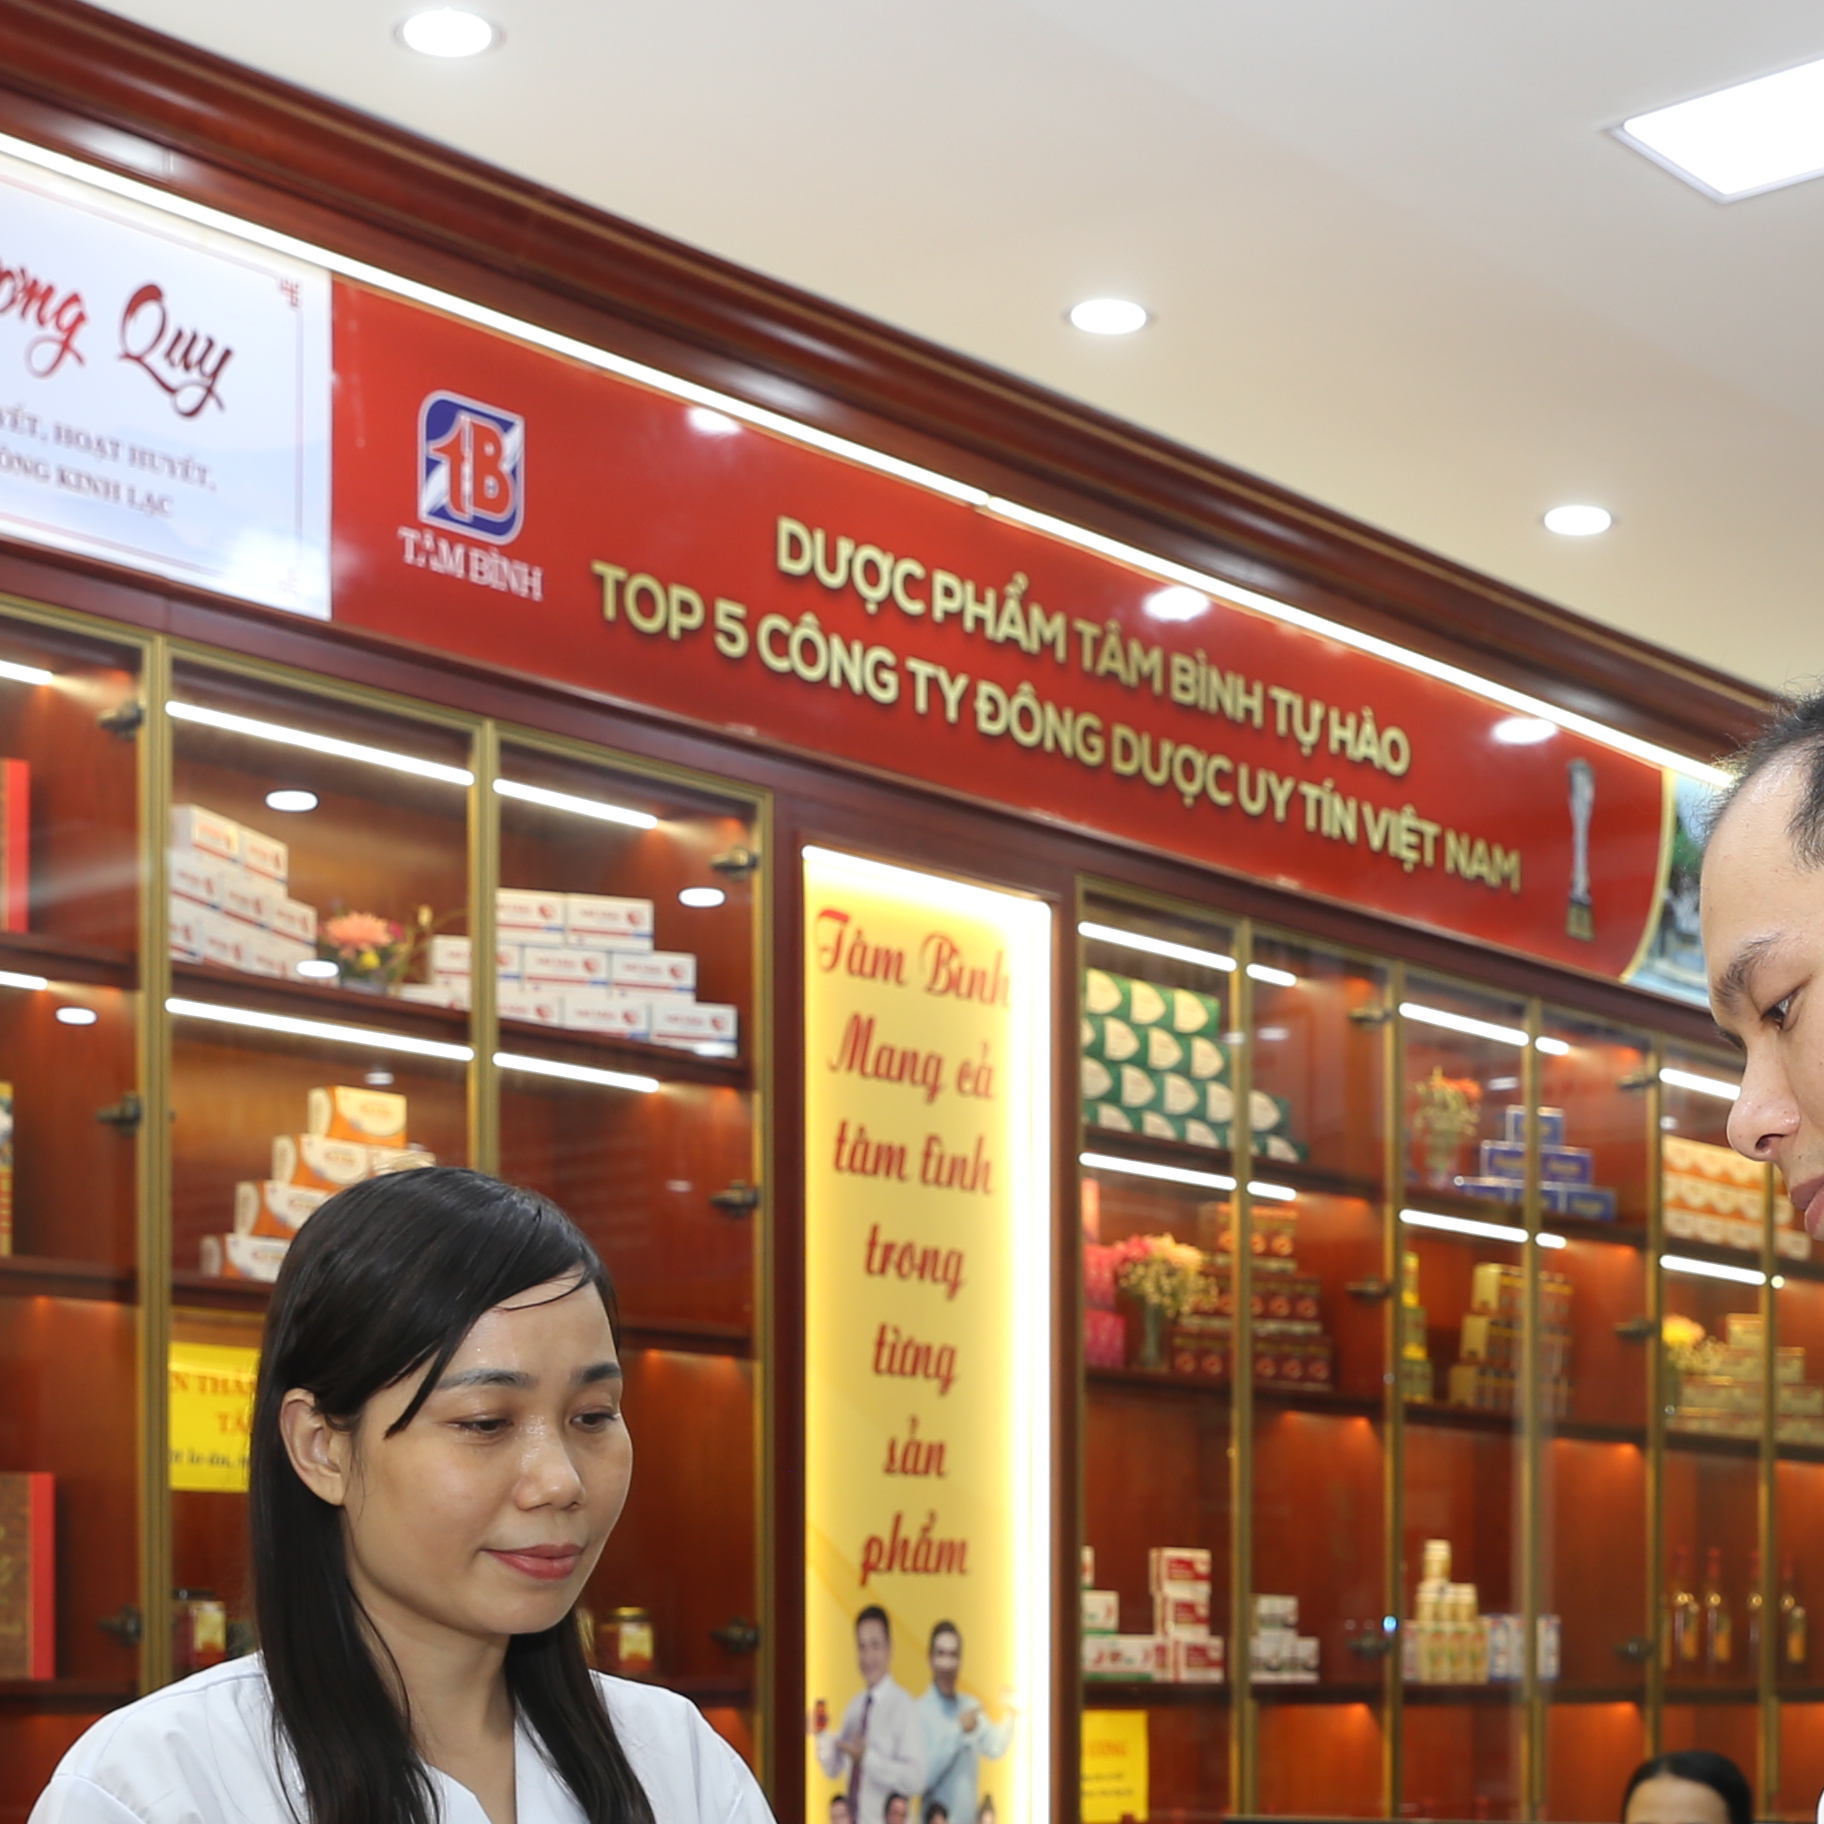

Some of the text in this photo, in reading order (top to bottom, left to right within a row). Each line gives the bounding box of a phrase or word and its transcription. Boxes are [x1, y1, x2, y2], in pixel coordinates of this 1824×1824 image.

[118, 283, 233, 419] Quy
[54, 422, 122, 462] HOẠT
[56, 466, 122, 503] KINH
[128, 485, 173, 517] LẠC
[398, 525, 543, 601] TÂM BÌNH
[777, 516, 1412, 777] DƯỢC PHẨM TÂM BÌNH TỰ HÀO
[592, 558, 1523, 894] TOP 5 CÔNG TY ĐÔNG DƯỢC UY TÍN VIỆT NAM
[815, 908, 910, 986] Tâm
[826, 1012, 996, 1105] Mang cả
[833, 1120, 995, 1197] tâm tình
[864, 1224, 965, 1300] trong
[871, 1323, 957, 1395] từng
[884, 1416, 947, 1478] sản
[859, 1511, 970, 1589] phẩm
